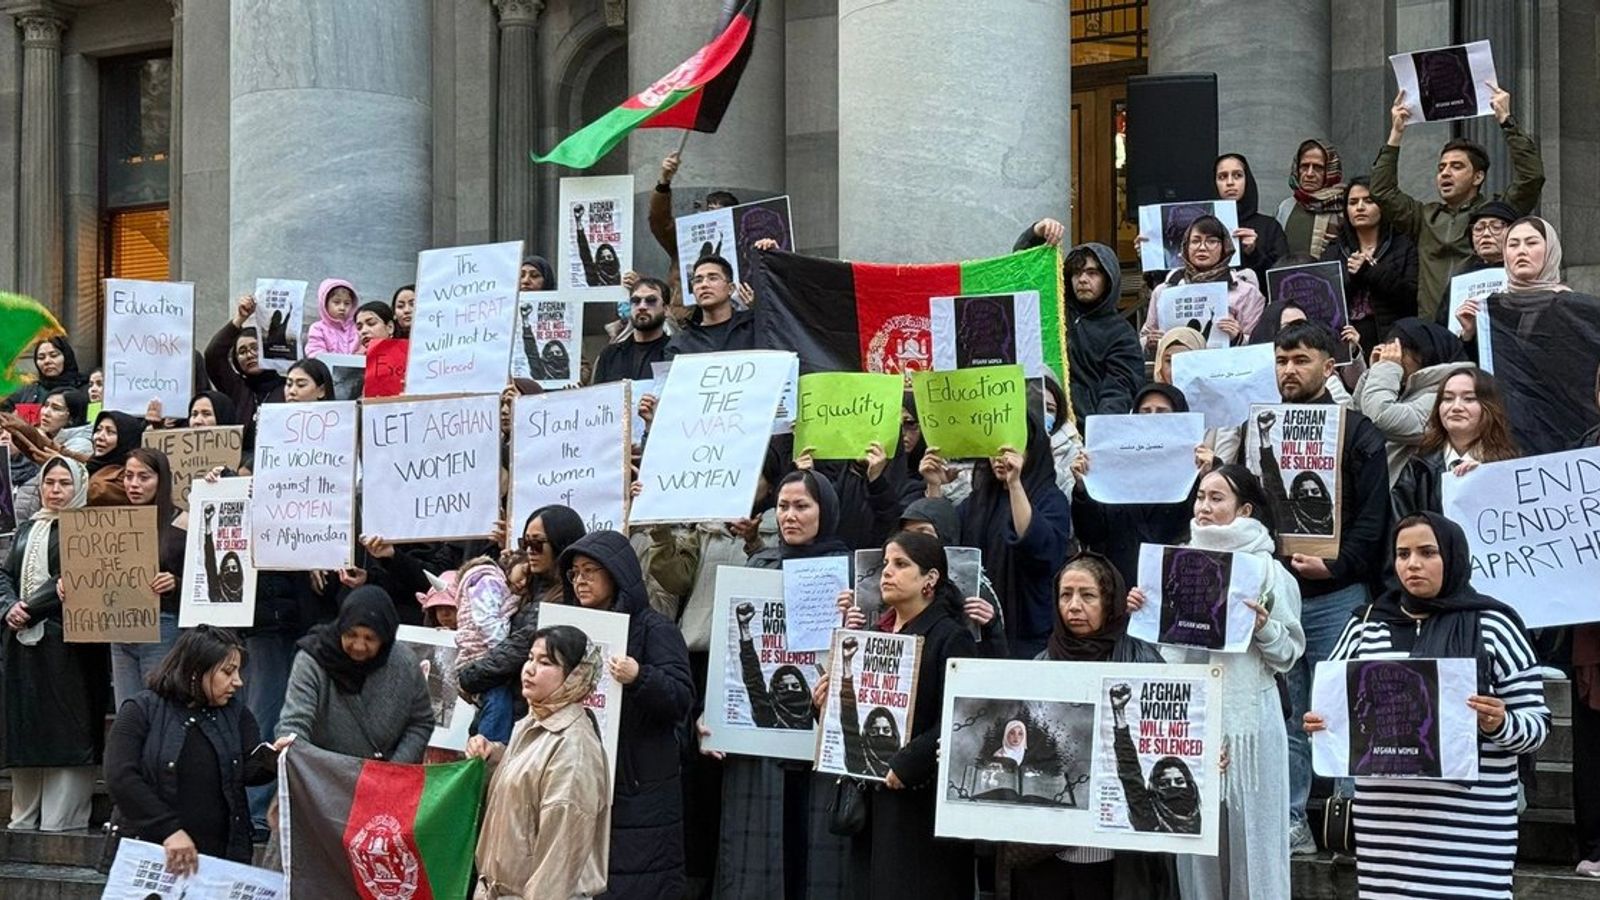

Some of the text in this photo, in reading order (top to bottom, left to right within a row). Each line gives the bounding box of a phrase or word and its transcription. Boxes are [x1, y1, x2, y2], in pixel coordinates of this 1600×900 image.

[455, 254, 479, 276] The
[113, 290, 184, 316] Education
[429, 297, 507, 328] of HERAT
[115, 333, 181, 356] WORK
[426, 328, 499, 352] will not be
[113, 361, 179, 398] Freedom
[700, 361, 756, 388] END
[927, 376, 1015, 403] Education
[699, 391, 743, 414] THE
[801, 392, 884, 426] Equality
[283, 410, 340, 444] STOP
[372, 408, 493, 447] LET AFGHAN
[529, 405, 614, 438] Stand with
[682, 414, 746, 440] WAR
[922, 404, 1012, 436] is a right
[1283, 410, 1327, 426] AFGHAN
[182, 430, 241, 455] STAND
[1283, 426, 1323, 441] WOMEN
[288, 449, 346, 468] violence
[561, 442, 582, 459] the
[692, 445, 724, 464] ON
[1281, 442, 1324, 456] WILL NOT
[394, 449, 476, 482] WOMEN
[1280, 456, 1334, 470] BE SILENCED
[268, 476, 336, 498] against the
[657, 470, 740, 492] WOMEN
[1515, 458, 1600, 505] END
[415, 492, 470, 519] LEARN
[560, 489, 574, 507] of
[73, 509, 139, 532] DON'T
[266, 500, 332, 520] WOMEN
[1478, 497, 1600, 544] GENDER
[67, 531, 144, 560] FORGET
[260, 524, 347, 551] of Afghanistan
[96, 557, 122, 572] THE
[65, 564, 156, 591] WOMEN
[103, 590, 119, 607] OF
[64, 607, 157, 633] AFGHANISTAN
[762, 634, 783, 648] WILL
[864, 637, 904, 658] AFGHAN
[762, 649, 816, 665] BE SILENCED
[863, 656, 900, 674] WOMEN
[860, 672, 900, 690] WILL NOT
[1140, 682, 1191, 701] AFGHAN
[858, 688, 909, 708] BE SILENCED
[1140, 702, 1188, 720] WOMEN
[1140, 720, 1190, 738] WILL NOT
[1138, 738, 1203, 756] BE SILENCED
[1373, 747, 1419, 755] AFGHAN WOMEN
